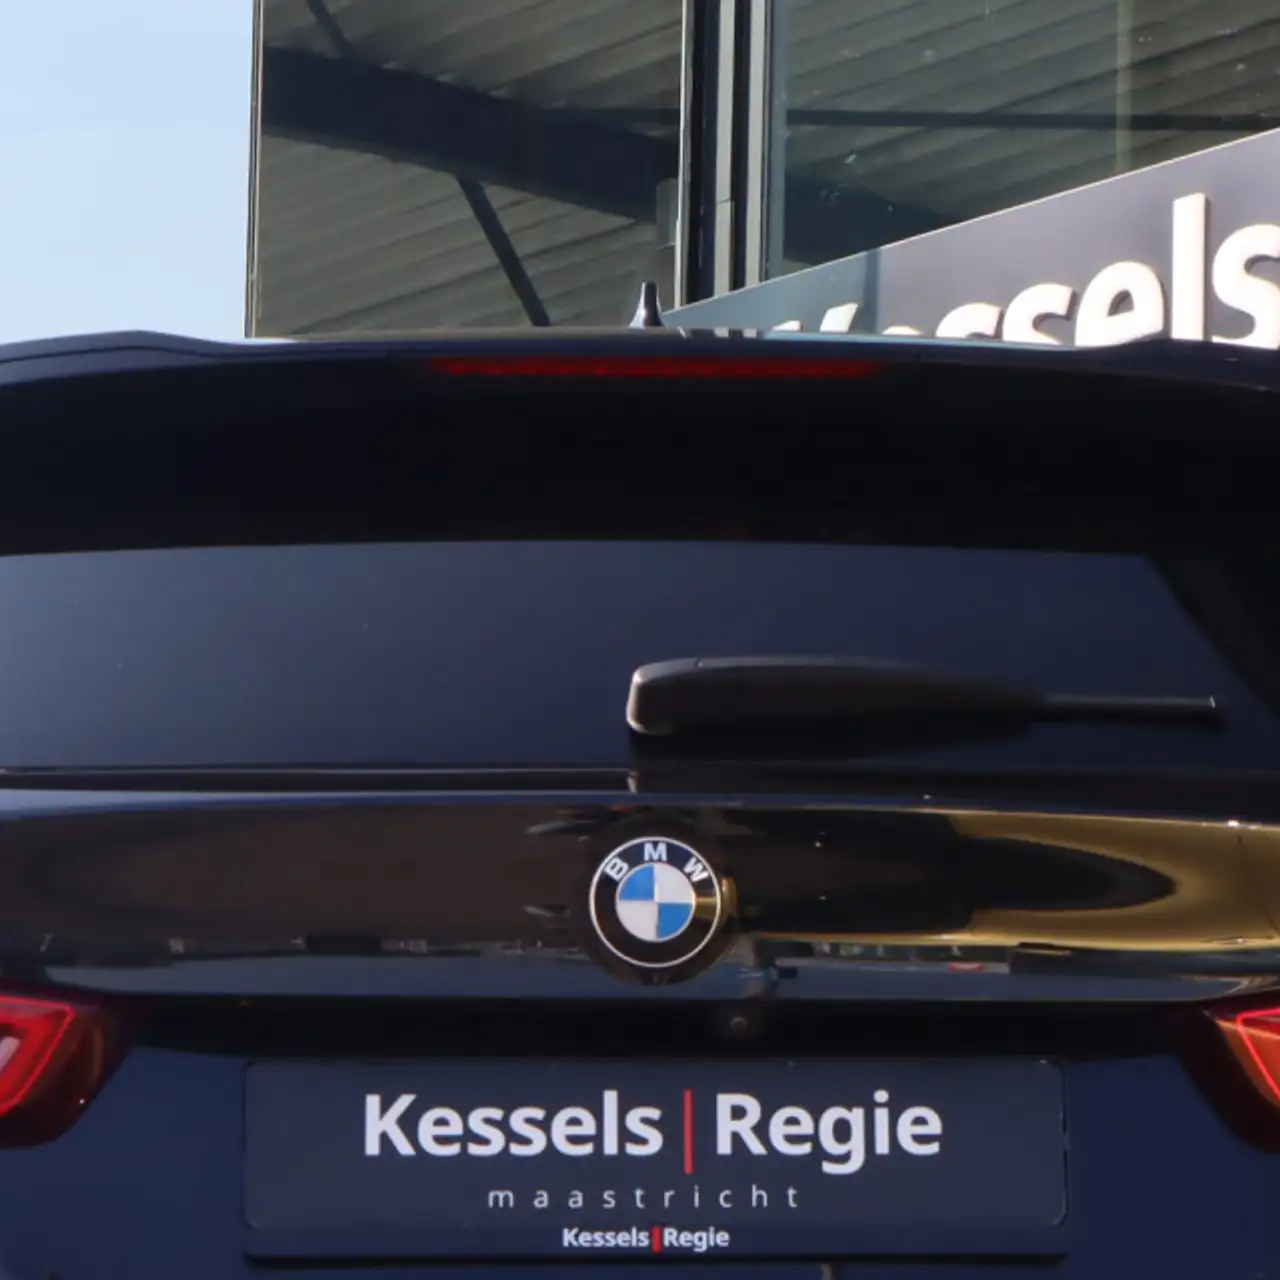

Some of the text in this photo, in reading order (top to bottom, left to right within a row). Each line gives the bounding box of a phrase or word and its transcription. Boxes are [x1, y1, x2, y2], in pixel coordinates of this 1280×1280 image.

[604, 842, 709, 882] BMW
[364, 1090, 943, 1174] Kessels Regie
[488, 1184, 798, 1209] maastricht
[562, 1226, 731, 1253] Kessels Regie
